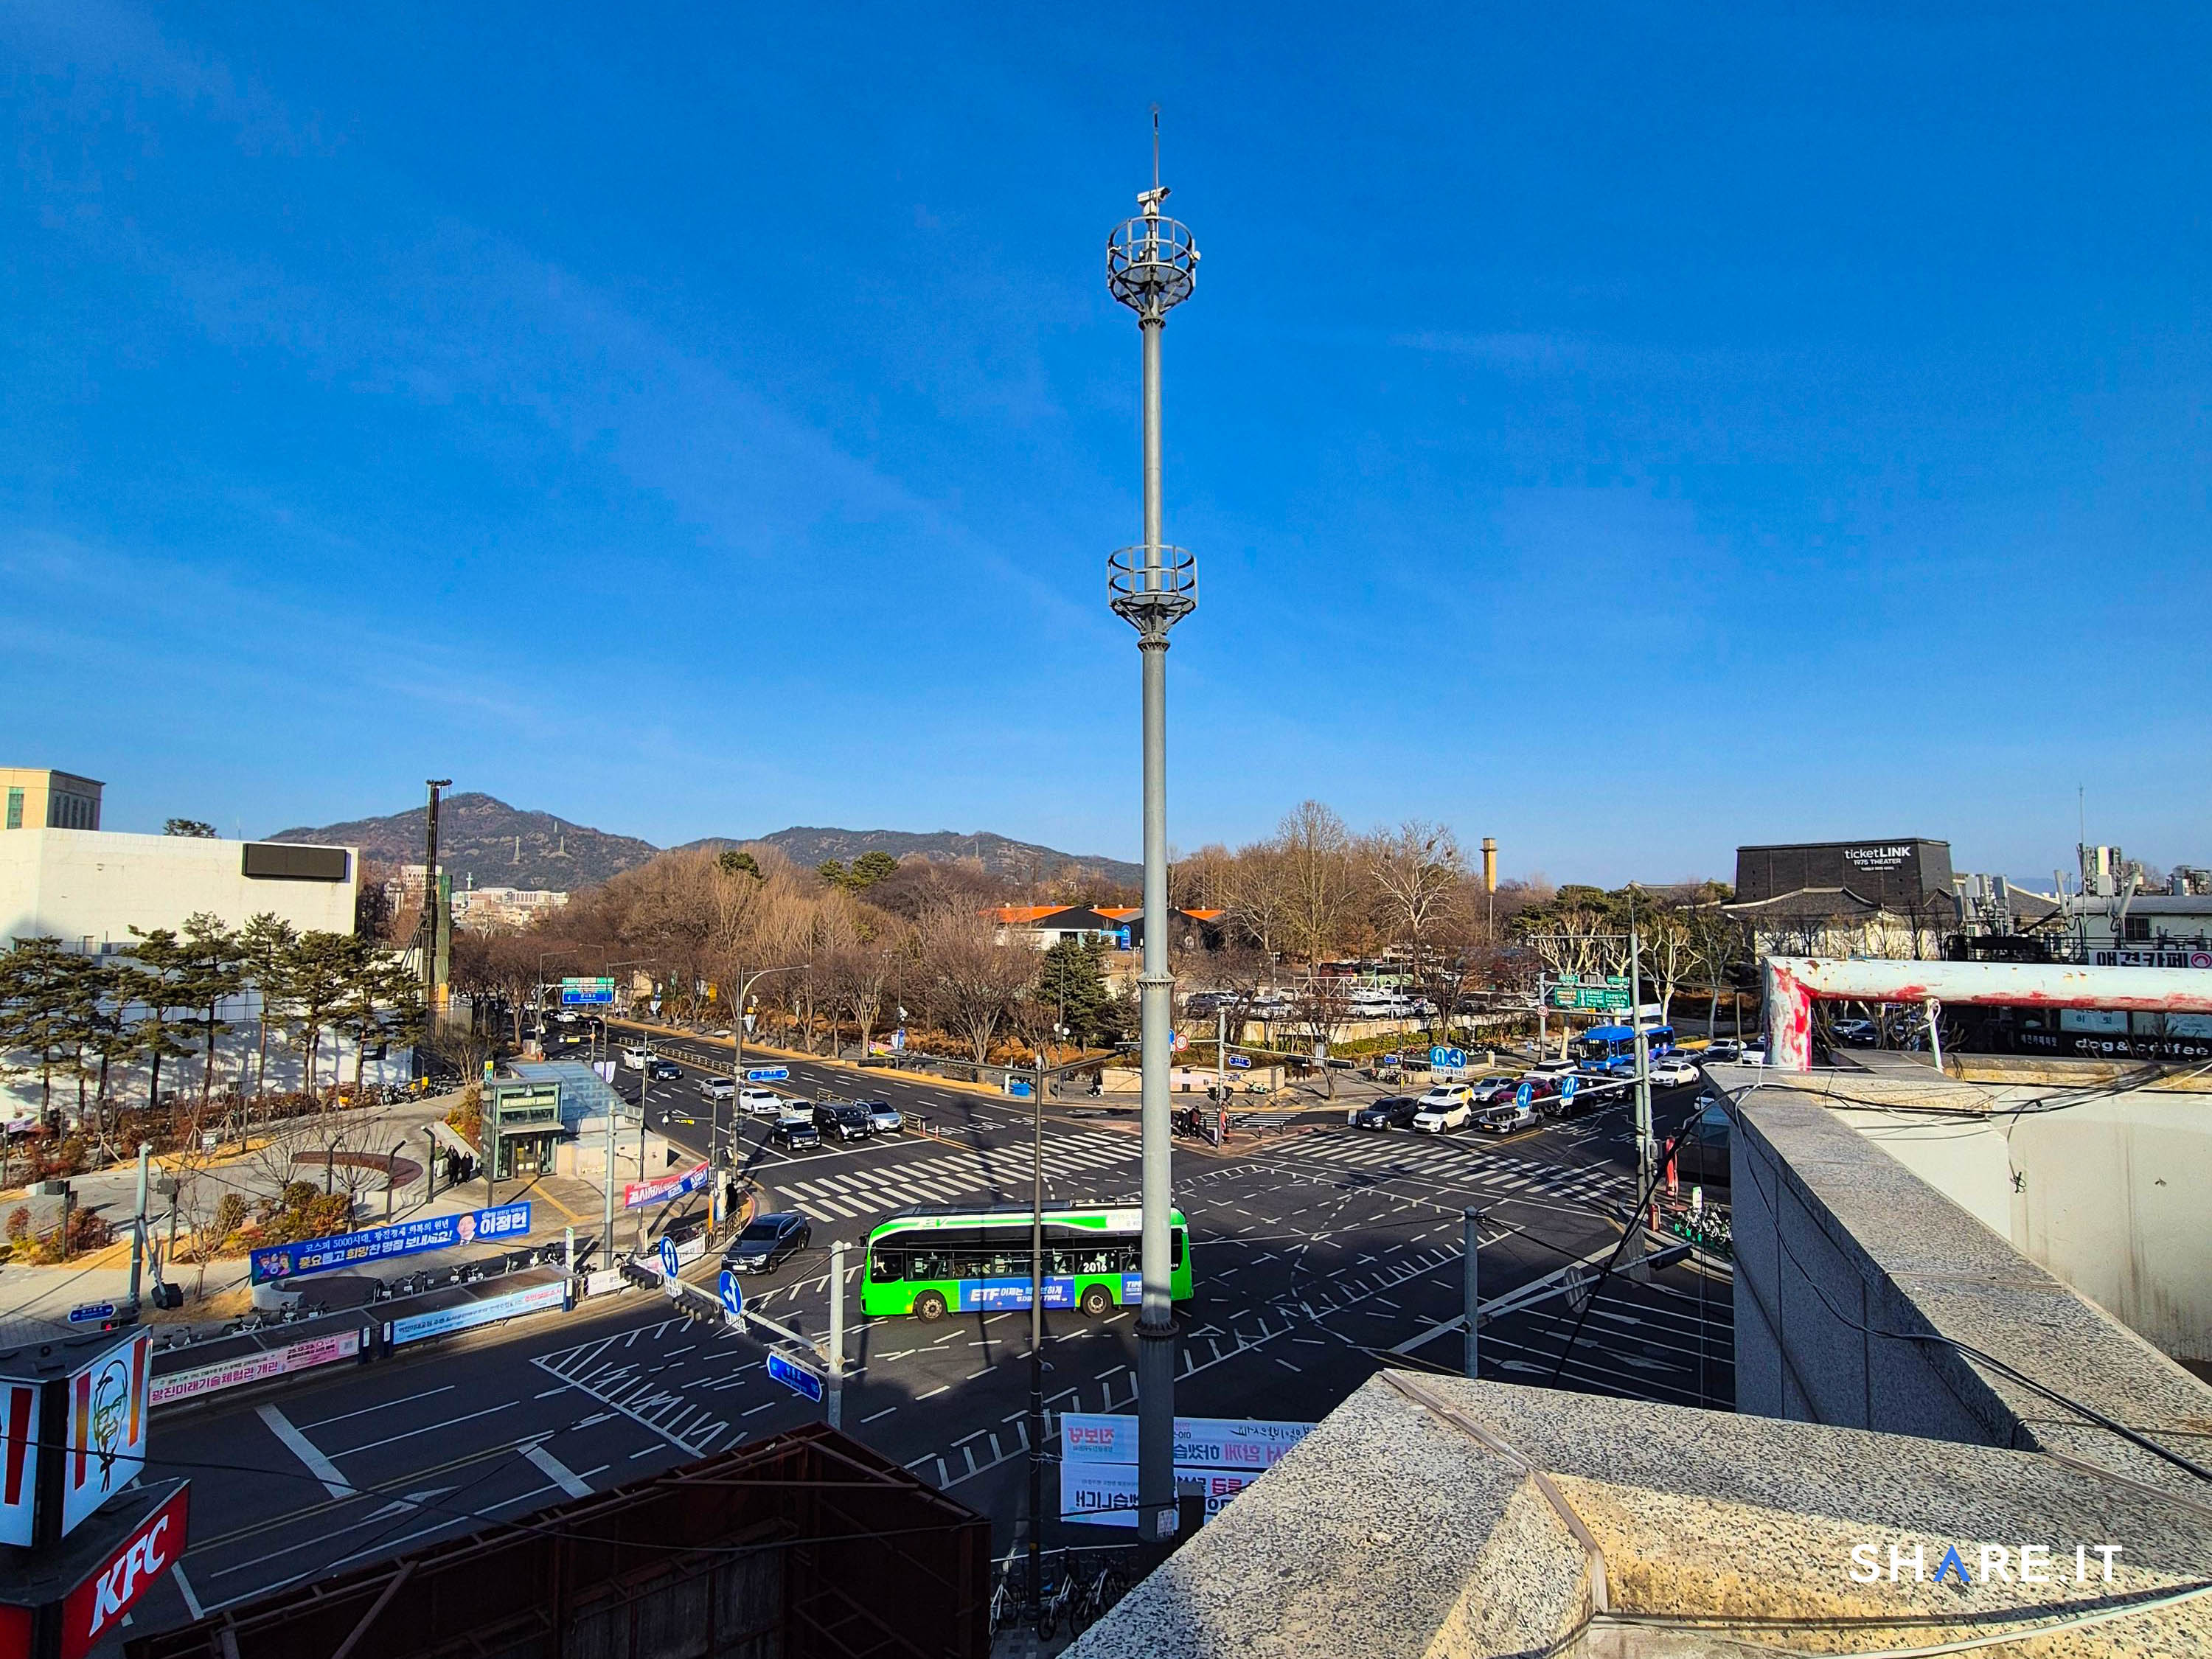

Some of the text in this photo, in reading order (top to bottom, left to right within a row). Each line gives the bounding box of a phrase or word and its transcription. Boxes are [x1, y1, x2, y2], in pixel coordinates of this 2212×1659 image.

[1844, 846, 1912, 859] ticketLINK
[2096, 951, 2189, 968] 애견카페
[480, 1211, 527, 1235] 이정헌
[299, 1230, 453, 1270] 풍요롭고 희망찬 명절 보내세요!
[305, 1239, 331, 1253] 코스피
[1083, 1262, 1107, 1273] 2016
[970, 1288, 1001, 1302] ETF
[152, 1368, 254, 1402] 광진미래기술체험관
[257, 1361, 279, 1375] 개관
[89, 1514, 169, 1638] KFC
